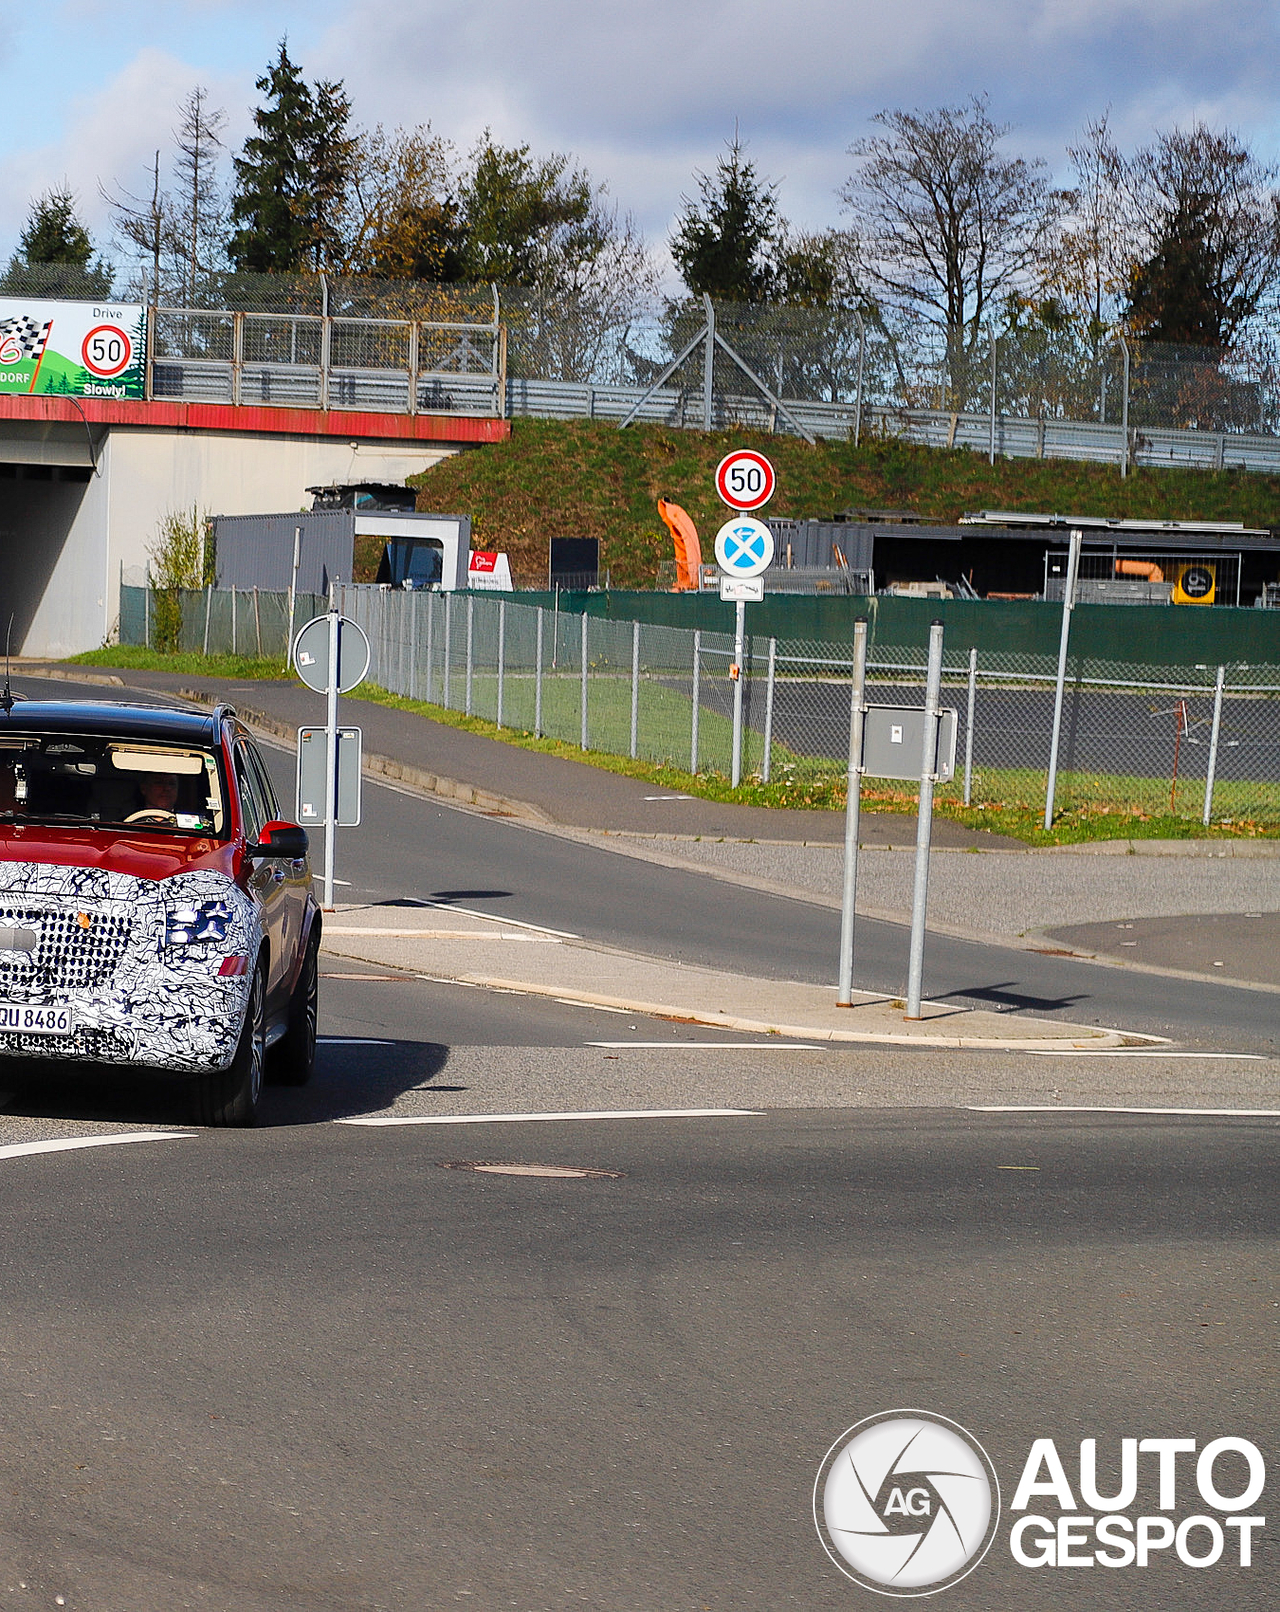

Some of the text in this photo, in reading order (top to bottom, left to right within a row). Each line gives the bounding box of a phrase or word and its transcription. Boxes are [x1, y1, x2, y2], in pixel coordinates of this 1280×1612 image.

[93, 307, 123, 319] Drive
[93, 338, 121, 362] 50
[83, 383, 126, 399] Slowly!
[731, 468, 761, 492] 50
[23, 1009, 67, 1030] 8486
